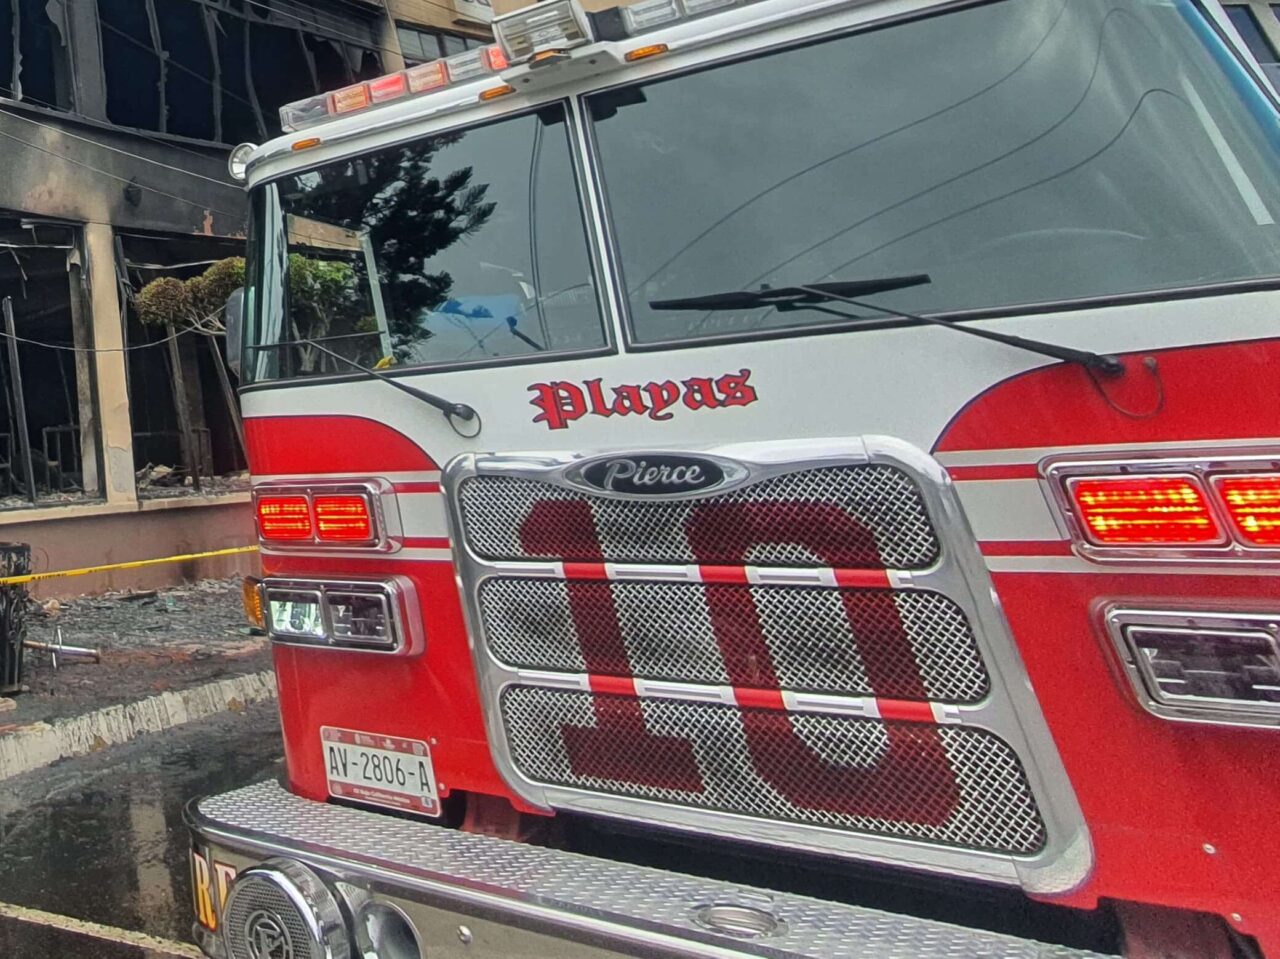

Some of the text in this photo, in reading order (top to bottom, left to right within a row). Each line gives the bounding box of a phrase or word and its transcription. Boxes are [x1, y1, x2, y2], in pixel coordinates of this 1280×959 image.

[526, 368, 759, 431] Playas
[603, 458, 706, 491] Pierce
[518, 498, 963, 830] 10
[328, 745, 432, 794] AV-2806-A
